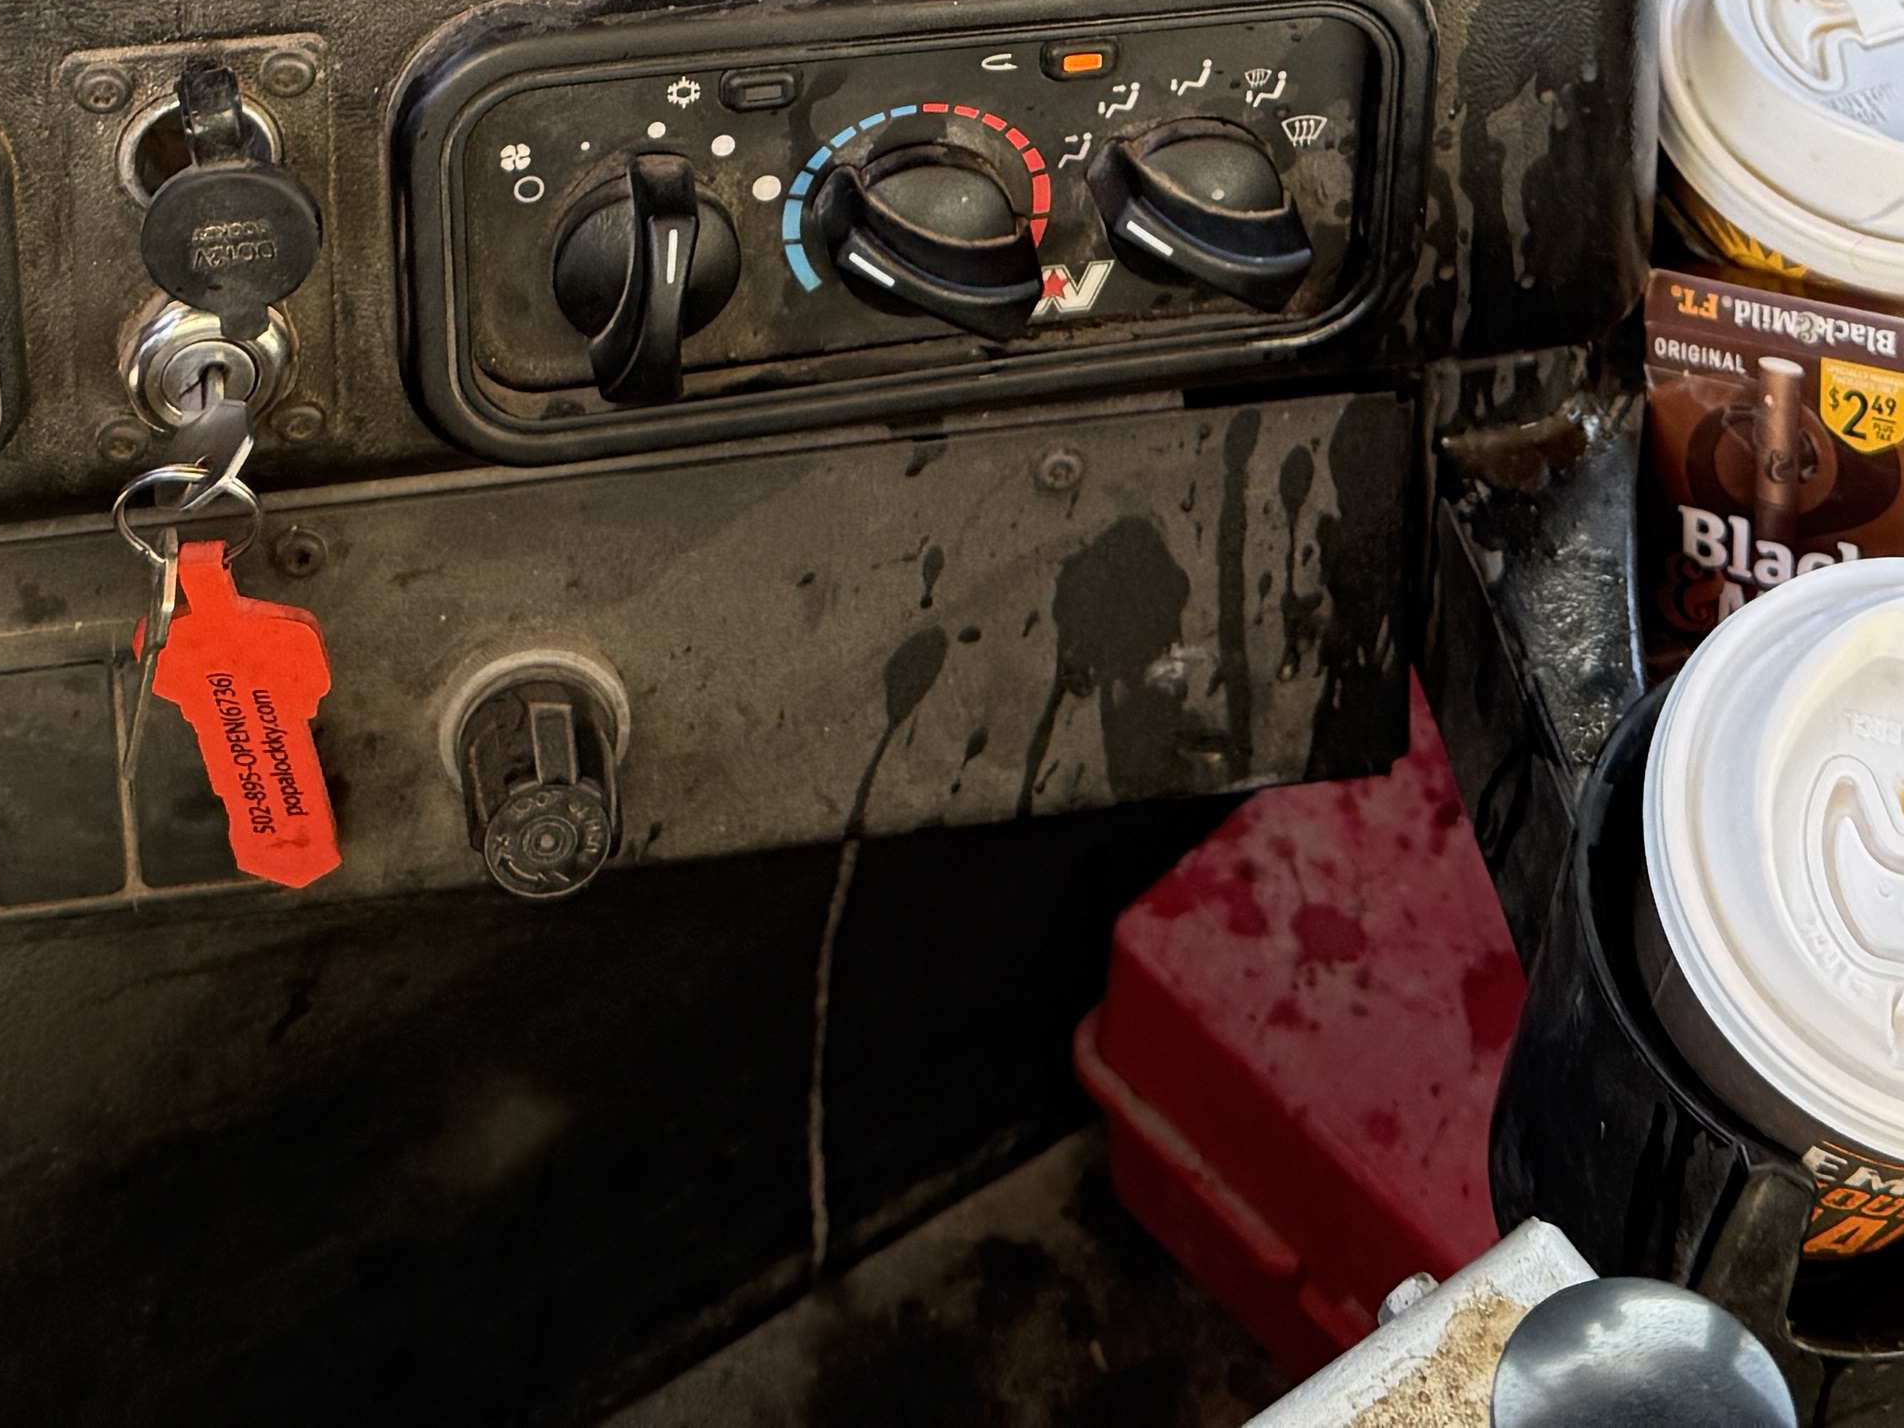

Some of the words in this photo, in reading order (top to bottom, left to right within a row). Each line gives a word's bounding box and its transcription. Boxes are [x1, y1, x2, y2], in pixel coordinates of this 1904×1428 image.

[1654, 337, 1747, 374] ORIGINAL
[206, 673, 275, 835] 502-895-OPEN(6736)
[252, 689, 308, 817] popalockky.com
